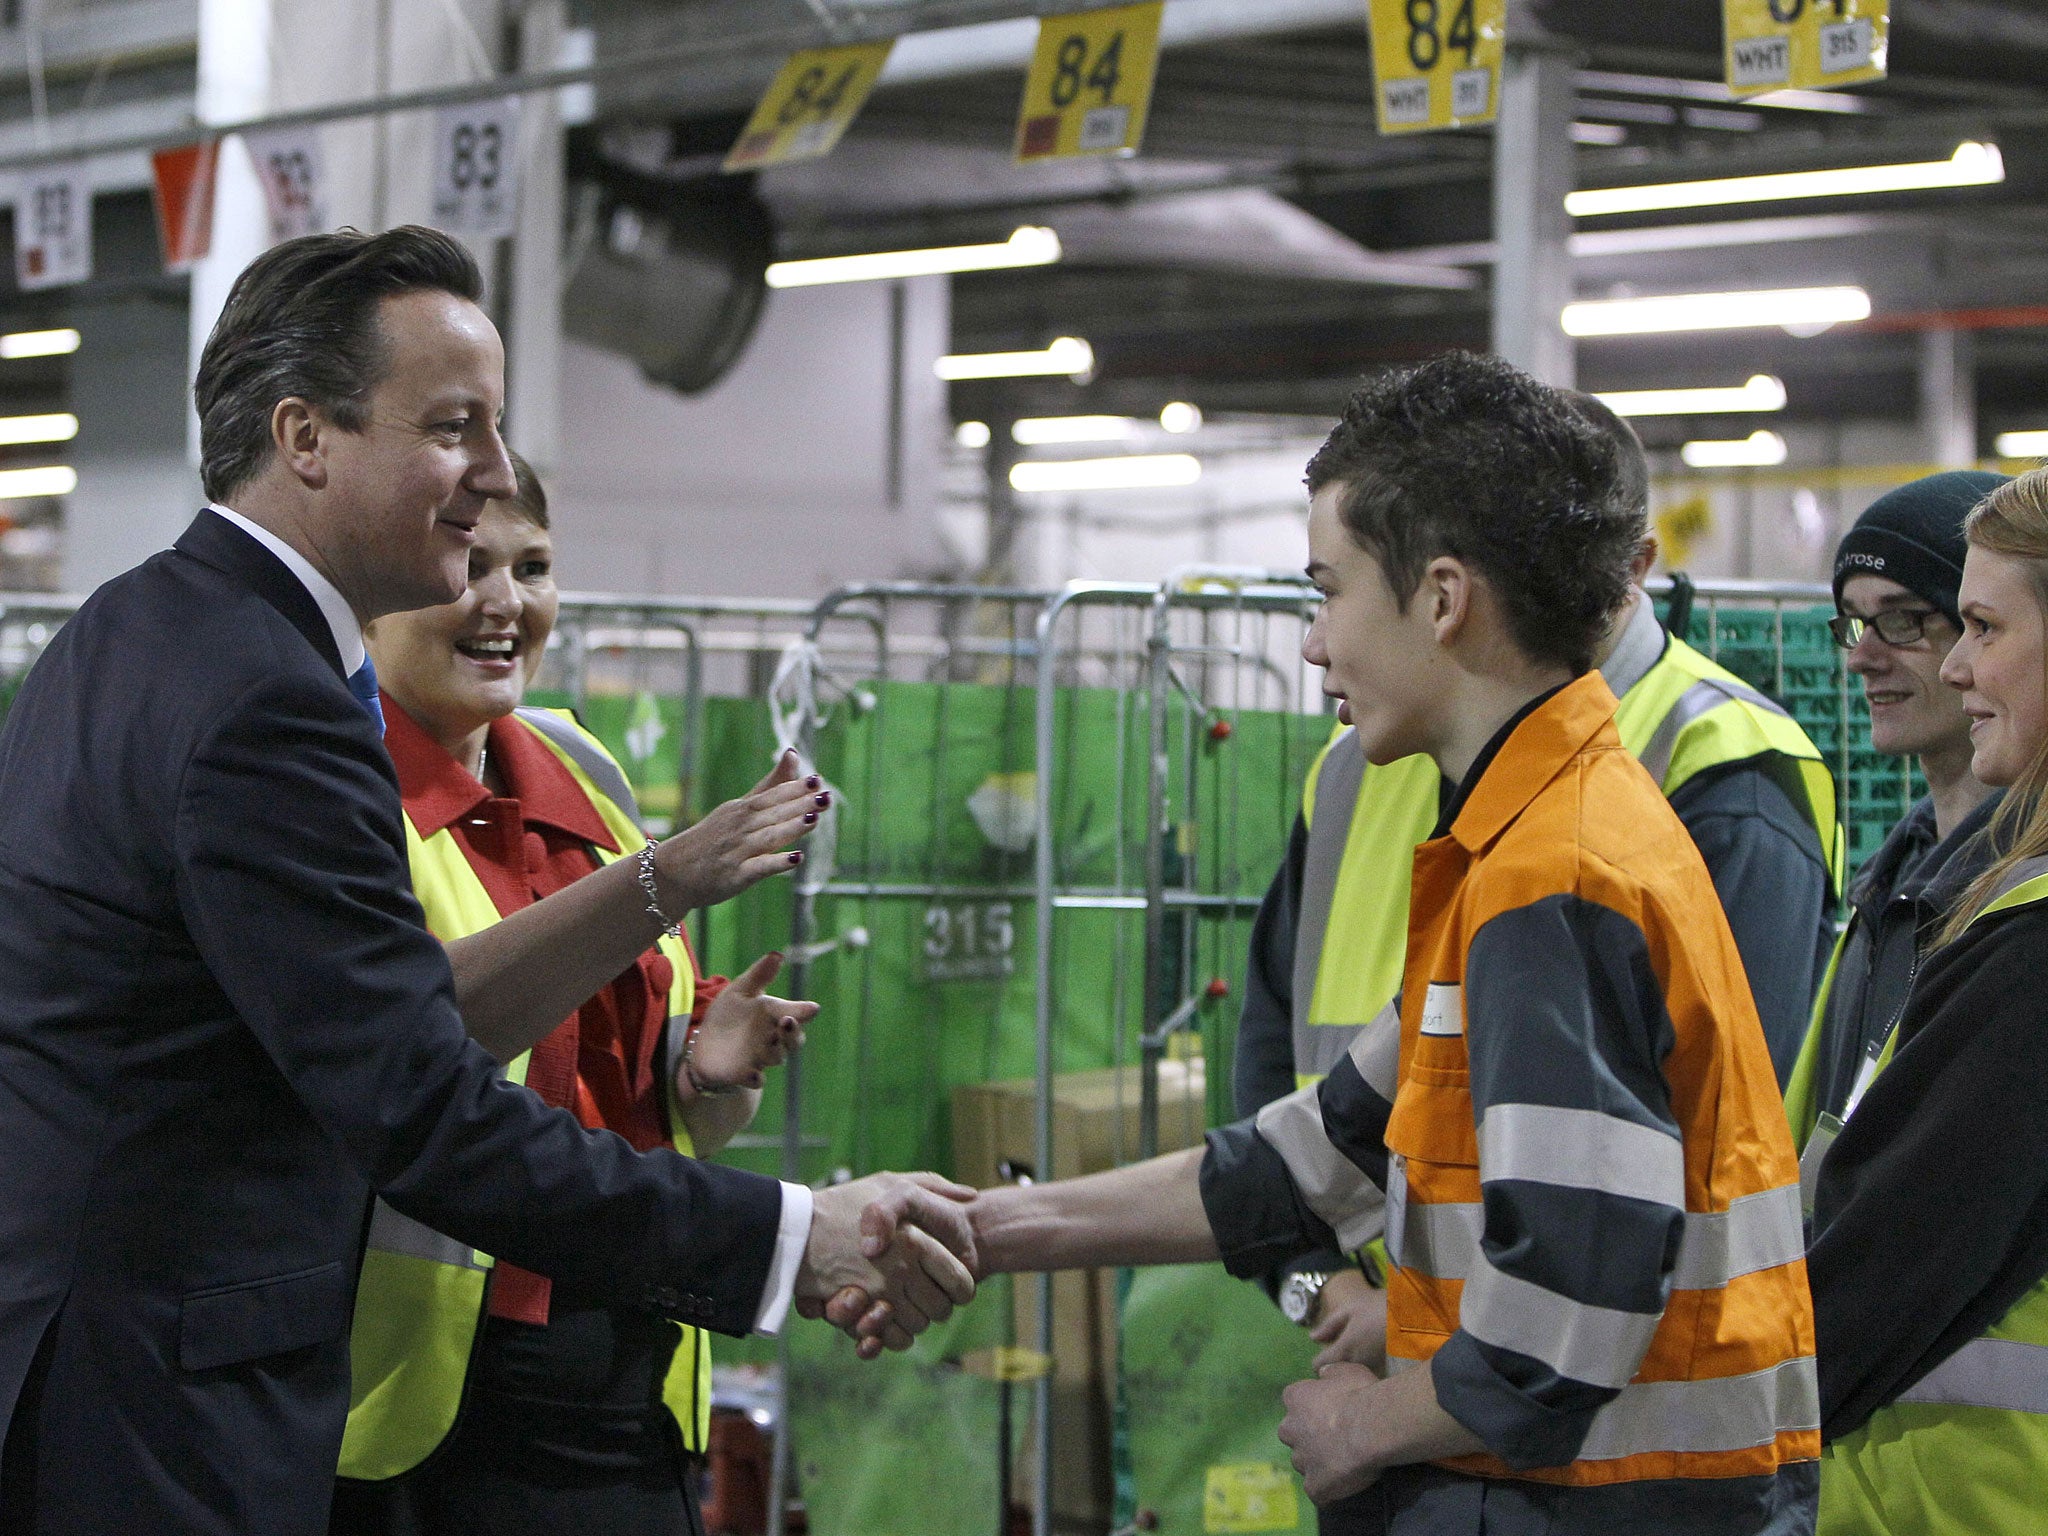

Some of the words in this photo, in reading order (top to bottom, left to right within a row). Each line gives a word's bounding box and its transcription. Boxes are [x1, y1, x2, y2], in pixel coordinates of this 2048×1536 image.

[1407, 0, 1477, 70] 84
[1737, 45, 1786, 70] WHT
[1829, 28, 1858, 57] 315
[778, 63, 861, 125] 84
[1051, 29, 1124, 107] 84
[451, 123, 501, 190] 83
[924, 903, 1013, 956] 315
